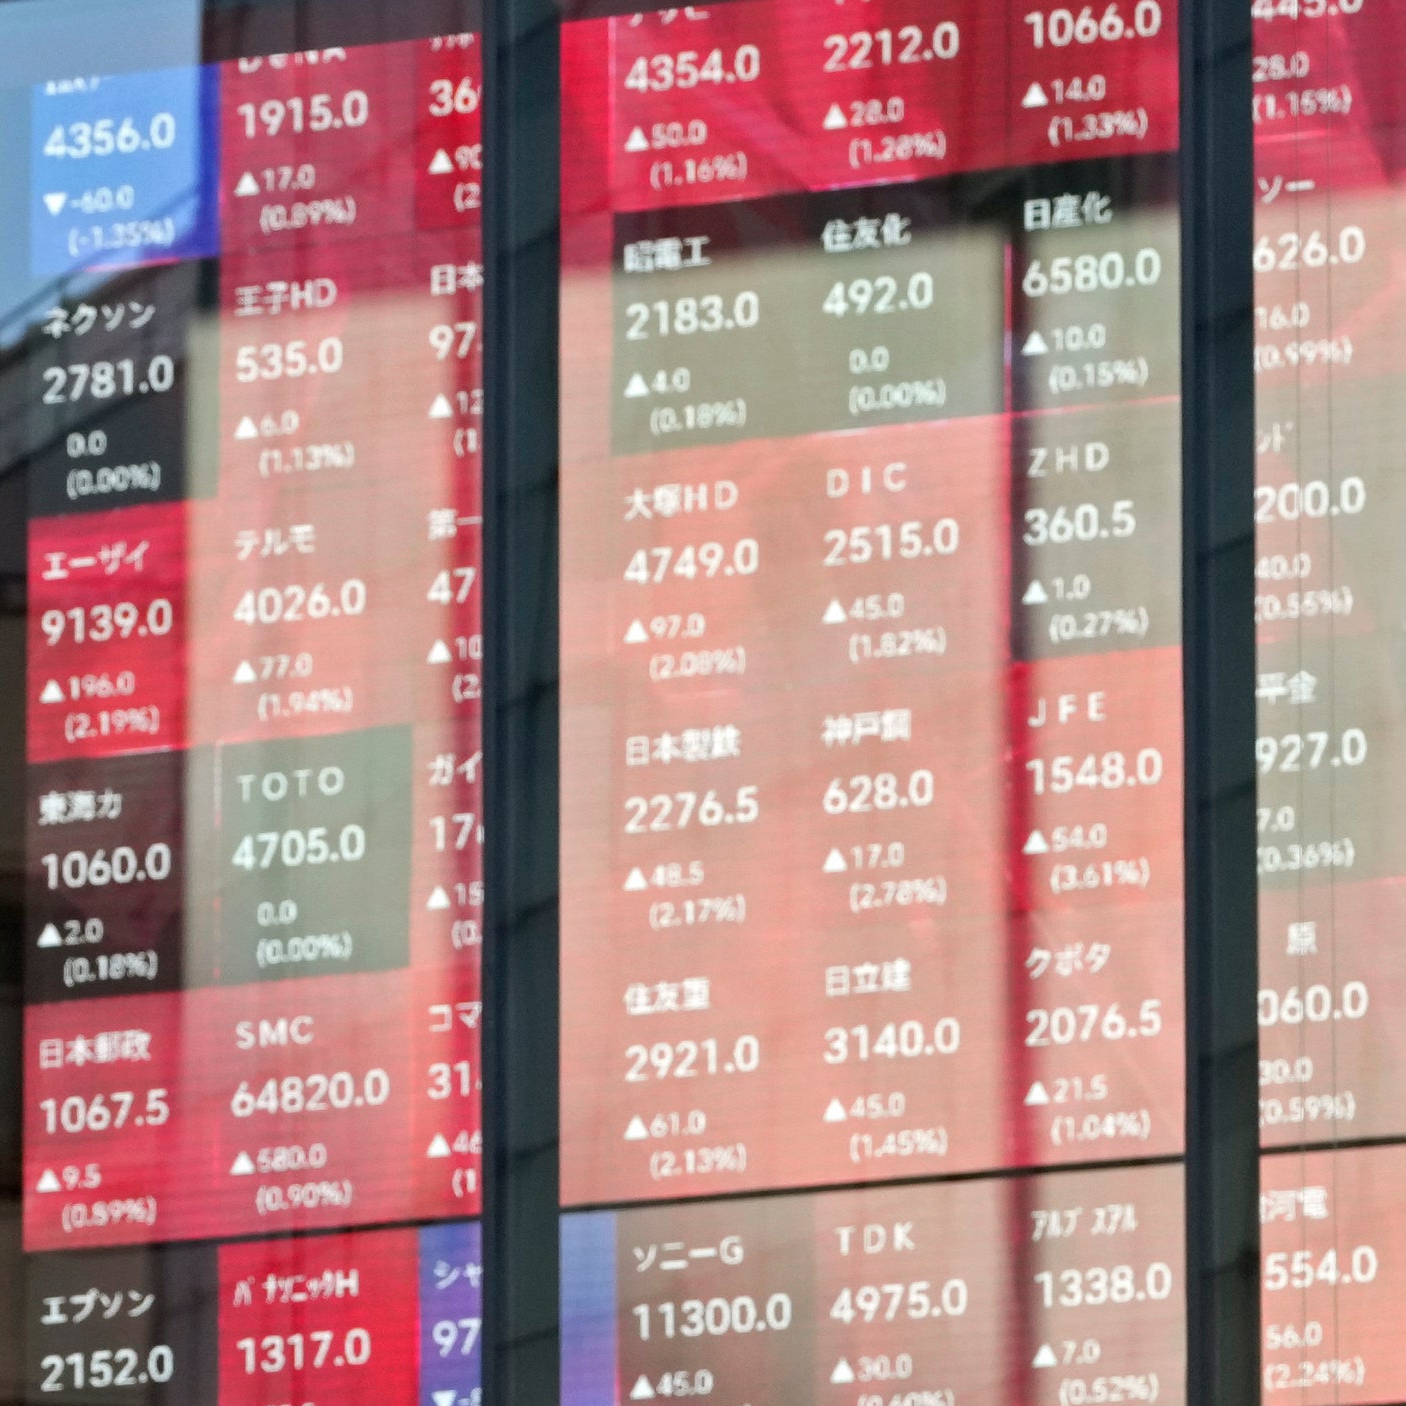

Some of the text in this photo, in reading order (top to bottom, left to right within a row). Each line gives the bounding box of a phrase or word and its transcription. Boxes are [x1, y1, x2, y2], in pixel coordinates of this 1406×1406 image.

[1025, 0, 1162, 48] 1066.0
[823, 21, 960, 72] 2212.0
[624, 44, 760, 92] 4354.0
[1052, 74, 1106, 103] 14.0
[238, 90, 369, 138] 1915.0
[1047, 108, 1149, 146] (1.33%)
[43, 112, 176, 158] 4356.0
[651, 119, 708, 149] 50.0
[263, 164, 316, 190] 17.0
[1024, 192, 1115, 234] 日産化
[822, 214, 913, 255] 住友化
[1024, 247, 1162, 295] 6580.0
[234, 278, 341, 319] 王子HD
[822, 272, 934, 316] 492.0
[40, 301, 155, 337] ネクソン
[626, 291, 759, 341] 2183.0
[1052, 323, 1106, 351] 10.0
[236, 336, 343, 383] 535.0
[1048, 357, 1149, 395] (0.15%)
[43, 354, 174, 404] 2781.0
[257, 410, 300, 436] 6.0
[66, 430, 107, 458] 0.0
[259, 443, 355, 475] (1.13%)
[1030, 442, 1110, 475] ZHD
[66, 462, 161, 500] (0.00%)
[827, 461, 907, 497] DIC
[1026, 500, 1136, 544] 360.5
[42, 541, 149, 581] エーザイ
[235, 524, 314, 561] テルモ
[624, 538, 759, 584] 4749.0
[824, 518, 959, 566] 2515.0
[233, 579, 366, 625] 4026.0
[849, 592, 905, 620] 45.0
[41, 598, 173, 645] 9139.0
[650, 613, 706, 637] 97.0
[1048, 606, 1149, 642] (0.27%)
[261, 652, 314, 679] 77.0
[69, 671, 135, 700] 196.0
[65, 706, 160, 742] (2.19%)
[1030, 691, 1104, 726] JFE
[237, 766, 345, 802] TOTO
[1029, 747, 1163, 794] 1548.0
[624, 785, 759, 834] 2276.5
[822, 769, 934, 815] 628.0
[41, 842, 171, 889] 1060.0
[232, 824, 365, 870] 4705.0
[852, 841, 905, 867] 17.0
[1050, 858, 1150, 892] (3.61%)
[61, 917, 104, 946] 2.0
[1029, 942, 1111, 978] クボタ
[236, 1016, 313, 1049] SMC
[824, 1017, 960, 1064] 3140.0
[1027, 998, 1162, 1045] 2076.5
[40, 1029, 151, 1069] 日本郵政
[625, 1035, 760, 1082] 2921.0
[231, 1067, 390, 1117] 64820.0
[1053, 1074, 1108, 1104] 21.5
[40, 1088, 169, 1134] 1067.5
[649, 1110, 707, 1138] 61.0
[650, 1143, 747, 1178] (2.13%)
[850, 1128, 948, 1162] (1.45%)
[59, 1163, 102, 1190] 9.5
[634, 1235, 744, 1271] ソニーG
[838, 1222, 914, 1255] TDK
[830, 1278, 968, 1323] 4975.0
[1038, 1262, 1173, 1307] 1338.0
[41, 1288, 154, 1325] エプソン
[634, 1292, 792, 1339] 11300.0
[41, 1345, 174, 1392] 2152.0
[237, 1327, 371, 1374] 1317.0
[1063, 1339, 1101, 1364] 7.0
[657, 1369, 714, 1396] 45.0
